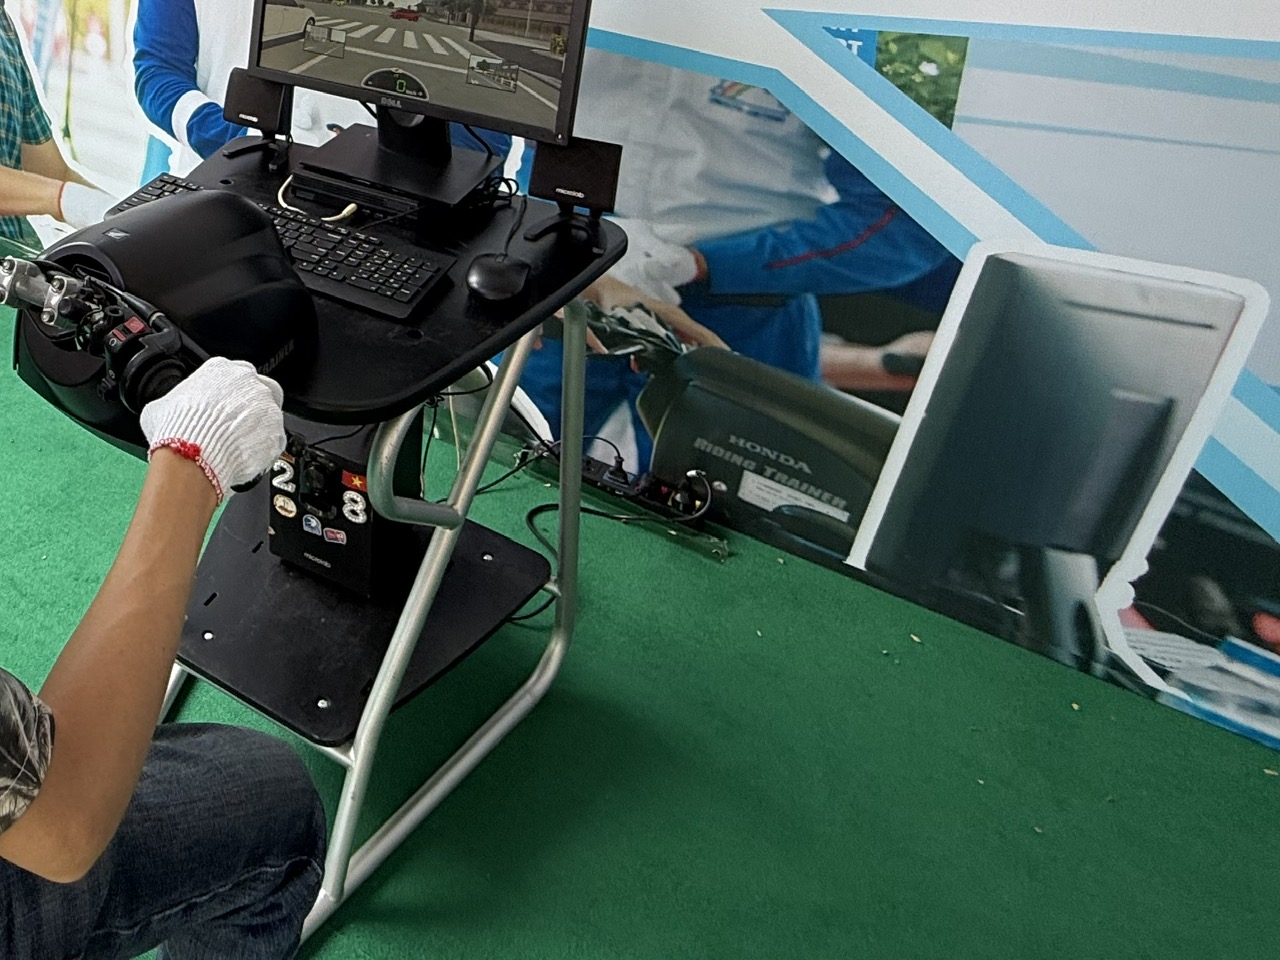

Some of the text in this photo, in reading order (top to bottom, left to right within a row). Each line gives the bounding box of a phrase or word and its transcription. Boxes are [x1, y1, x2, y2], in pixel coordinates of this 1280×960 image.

[728, 434, 813, 475] HONDA
[271, 459, 296, 493] 2
[693, 437, 757, 471] RIDING
[763, 465, 848, 510] TRAINER
[342, 490, 368, 524] 8
